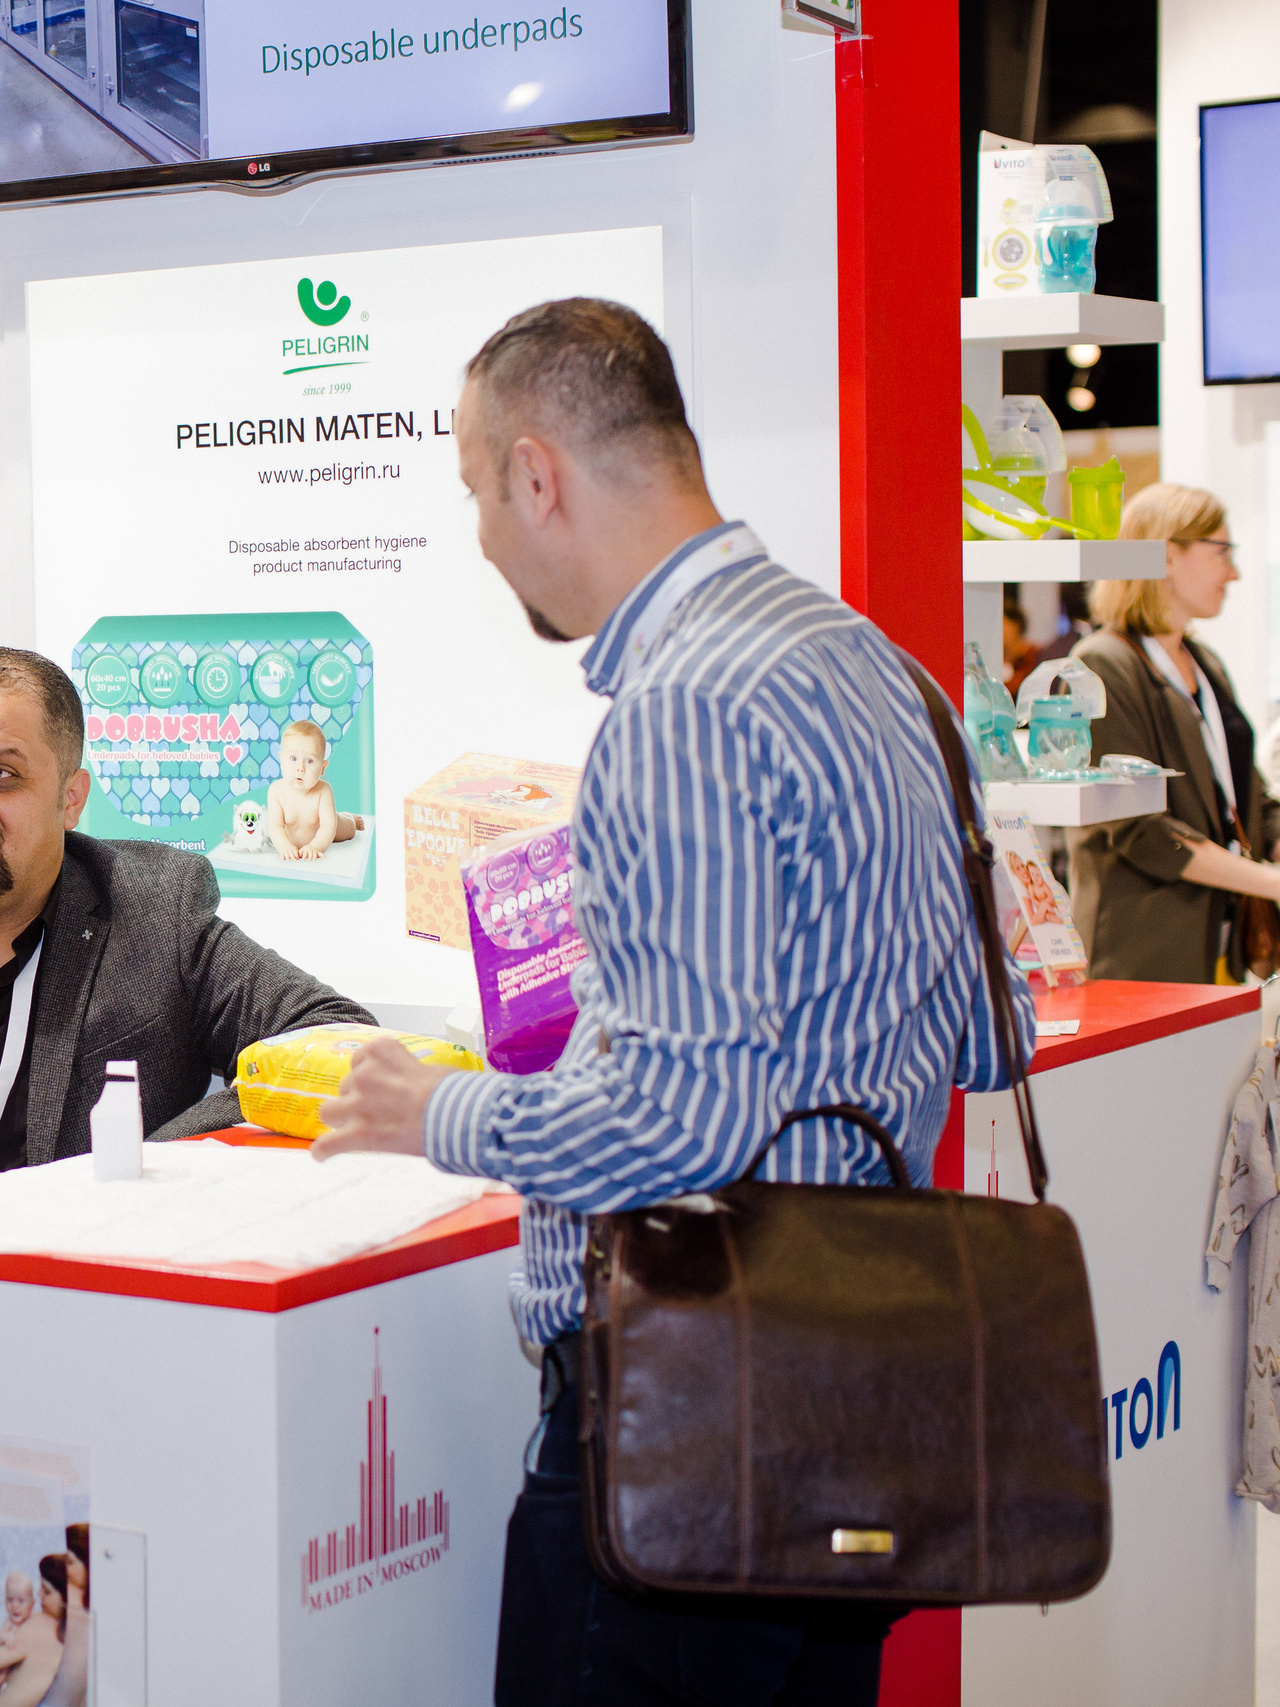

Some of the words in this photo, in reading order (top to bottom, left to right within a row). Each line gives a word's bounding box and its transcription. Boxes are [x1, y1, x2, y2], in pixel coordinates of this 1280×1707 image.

[261, 27, 414, 76] Disposable
[423, 6, 583, 54] underpads
[258, 162, 271, 173] LG
[282, 334, 370, 357] PELIGRIN
[302, 384, 326, 396] since
[328, 382, 352, 395] 1999
[176, 417, 305, 449] PELIGRIN
[315, 410, 423, 442] MATEN,
[433, 408, 456, 435] L
[258, 461, 401, 486] www.peligrin.ru
[228, 539, 300, 555] Disposable
[303, 536, 371, 552] absorbent
[374, 534, 427, 551] hygiene
[253, 559, 303, 576] product
[306, 556, 402, 573] manufacturing
[96, 683, 106, 692] 20
[107, 684, 121, 693] pcs
[86, 713, 241, 743] DOBRUSHA
[87, 751, 136, 762] Underpads
[137, 750, 150, 760] for
[152, 750, 188, 760] beloved
[189, 750, 219, 760] babies
[412, 804, 460, 831] BELLE
[150, 838, 206, 851] orbent
[497, 953, 547, 982] Disposable
[498, 962, 547, 992] Underpads
[545, 956, 561, 971] for
[560, 944, 590, 964] Babie
[499, 986, 520, 1003] with
[519, 969, 561, 995] Adhesive
[309, 1581, 353, 1614] MADE
[357, 1571, 374, 1594] IN
[380, 1541, 445, 1585] MOSCOW
